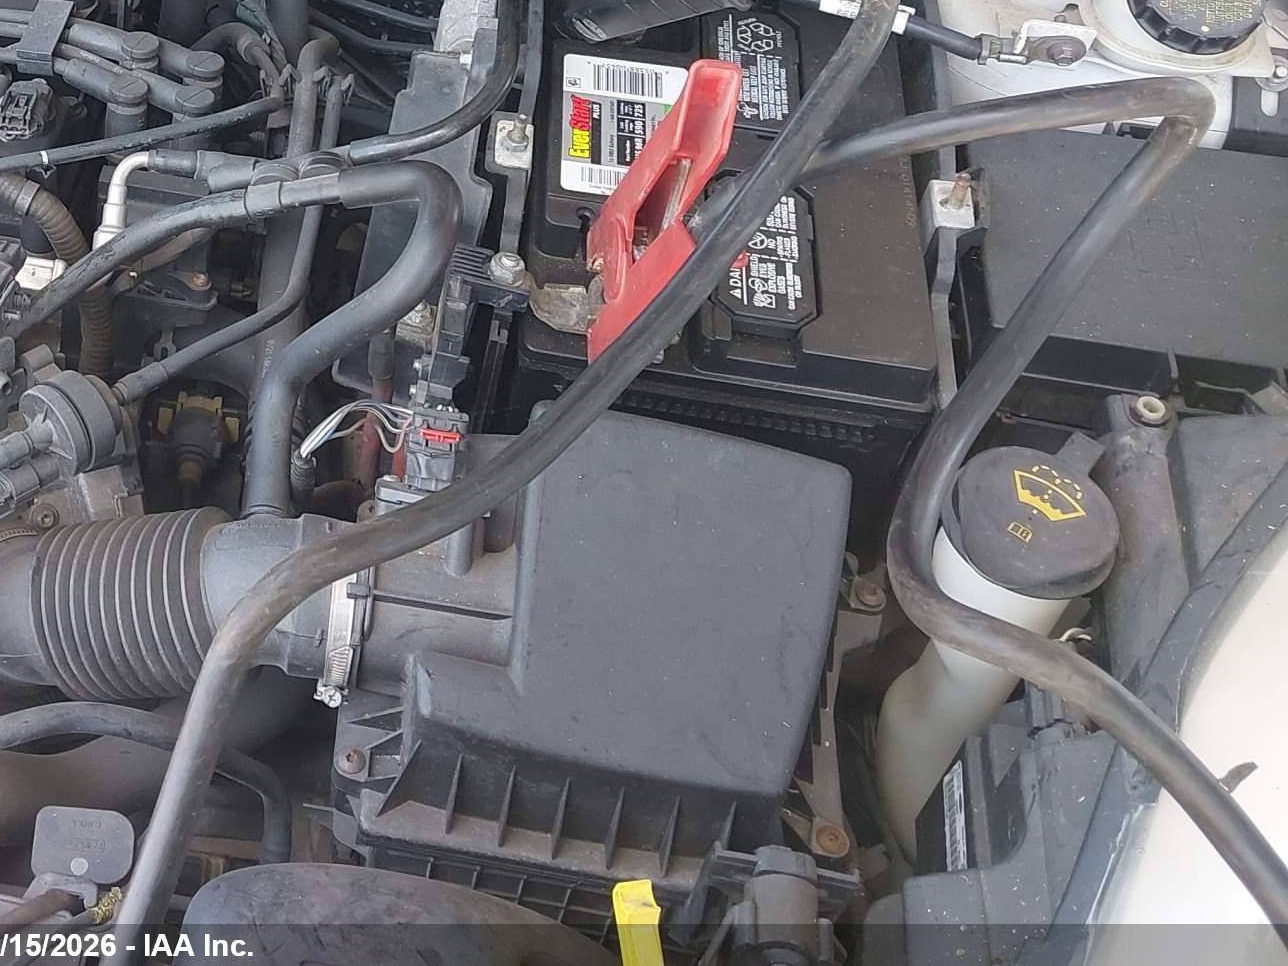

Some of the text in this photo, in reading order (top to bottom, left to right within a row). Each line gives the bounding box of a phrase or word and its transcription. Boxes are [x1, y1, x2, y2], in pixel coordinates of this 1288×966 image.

[634, 104, 644, 117] 725
[567, 94, 590, 159] EverStart
[634, 120, 644, 135] 590
[634, 138, 644, 150] 96R
[768, 239, 776, 249] NO
[750, 256, 759, 277] SHIELD
[759, 263, 767, 278] EYES
[767, 262, 777, 293] EXPLOSIVE
